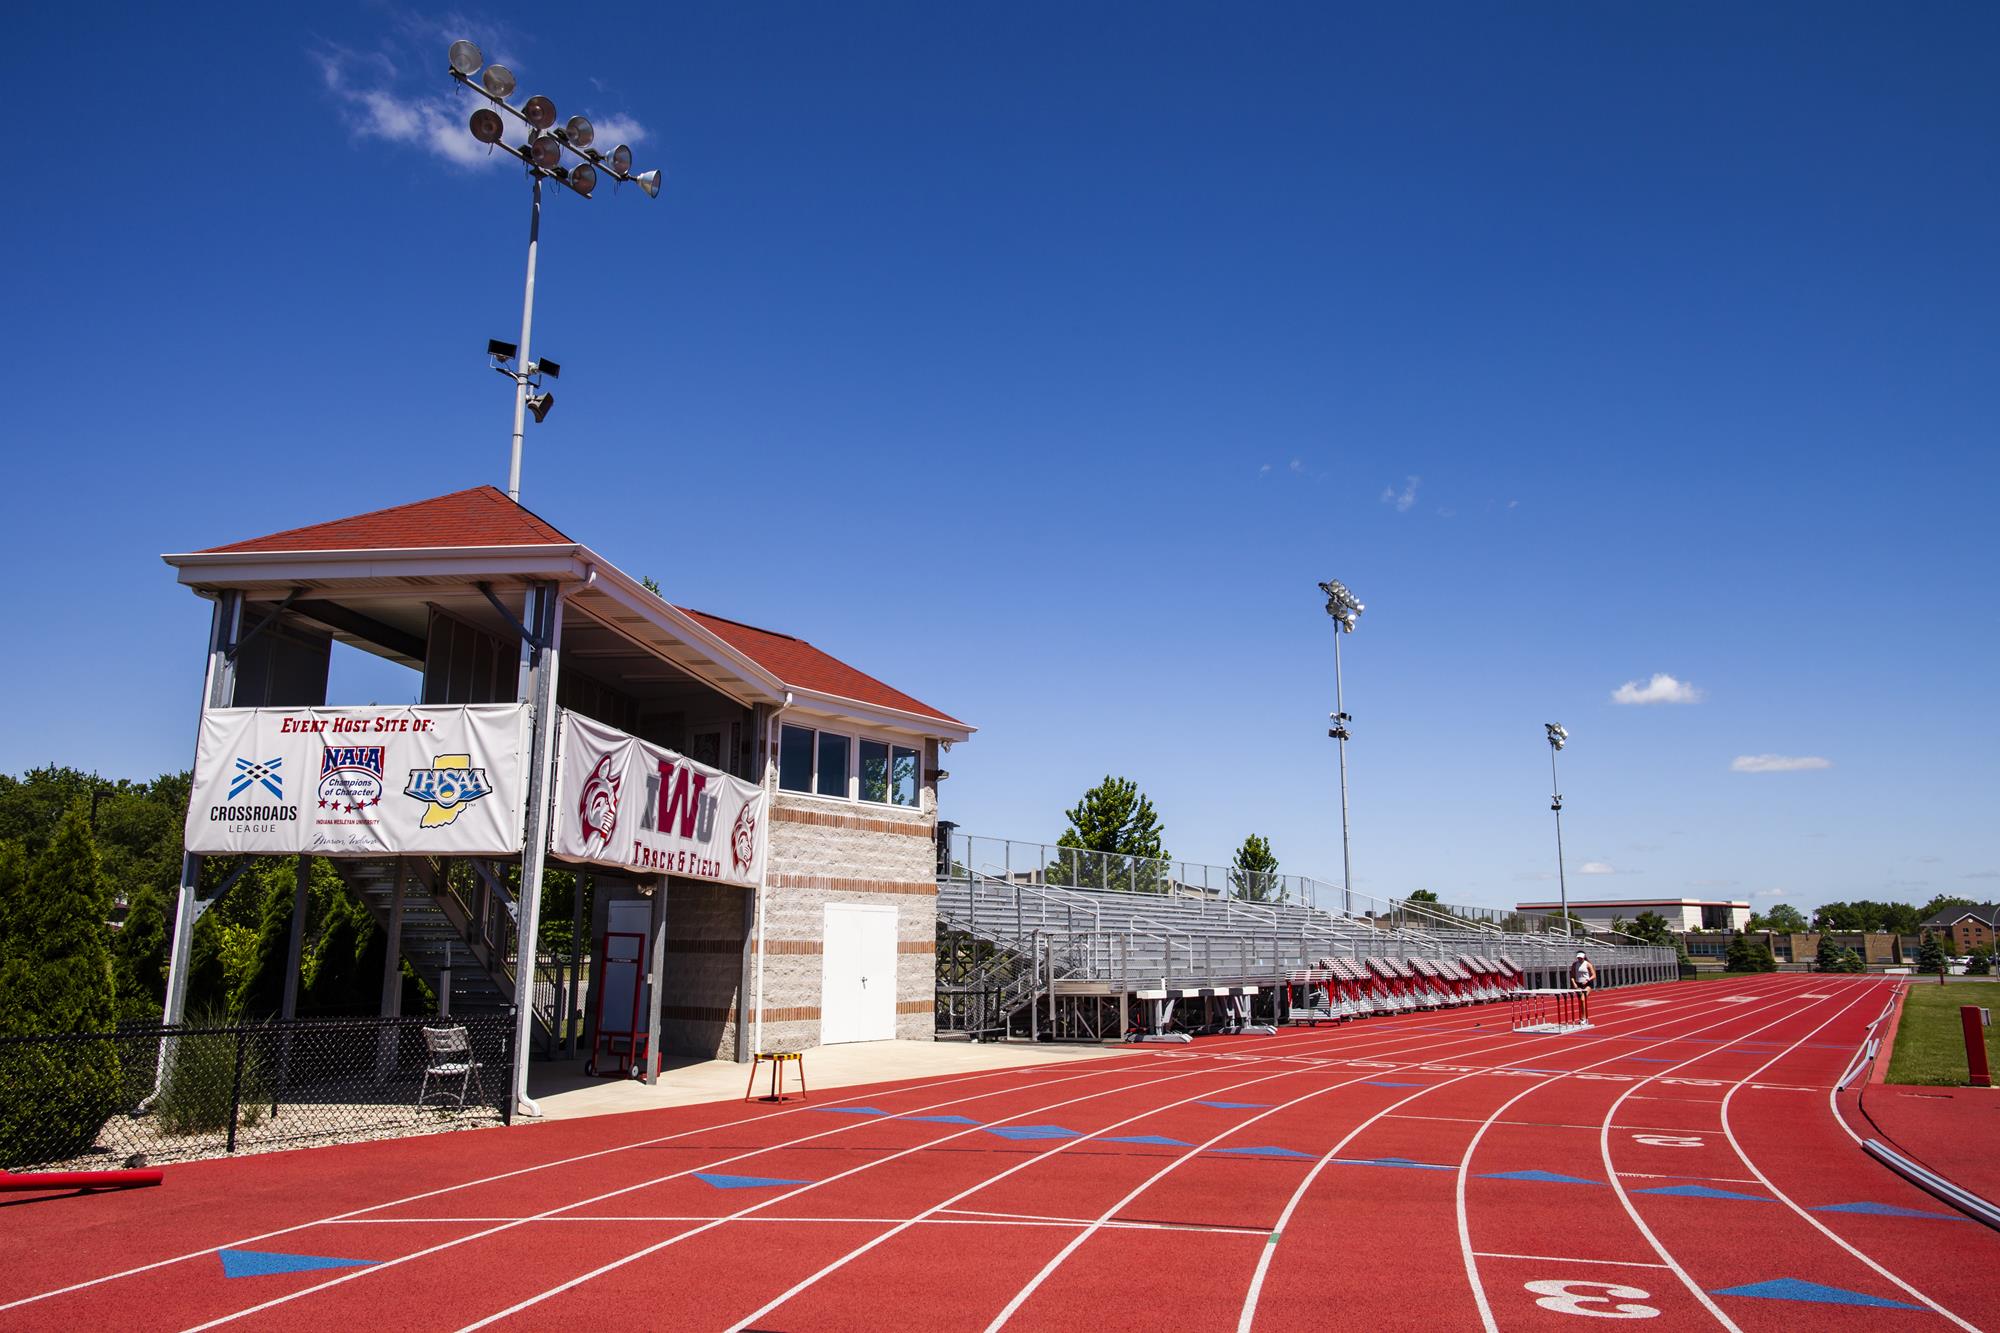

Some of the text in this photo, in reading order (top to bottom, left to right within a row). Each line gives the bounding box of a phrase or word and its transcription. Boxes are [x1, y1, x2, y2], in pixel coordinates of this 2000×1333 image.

[322, 747, 382, 775] NAIA
[328, 778, 373, 788] Champions
[405, 768, 489, 803] IHSAA
[324, 788, 375, 796] of Character
[210, 805, 298, 821] CROSSROADS
[228, 824, 277, 833] LEAGUE
[677, 850, 686, 873] &
[1631, 1133, 1705, 1147] 2
[1523, 1279, 1662, 1319] 3
